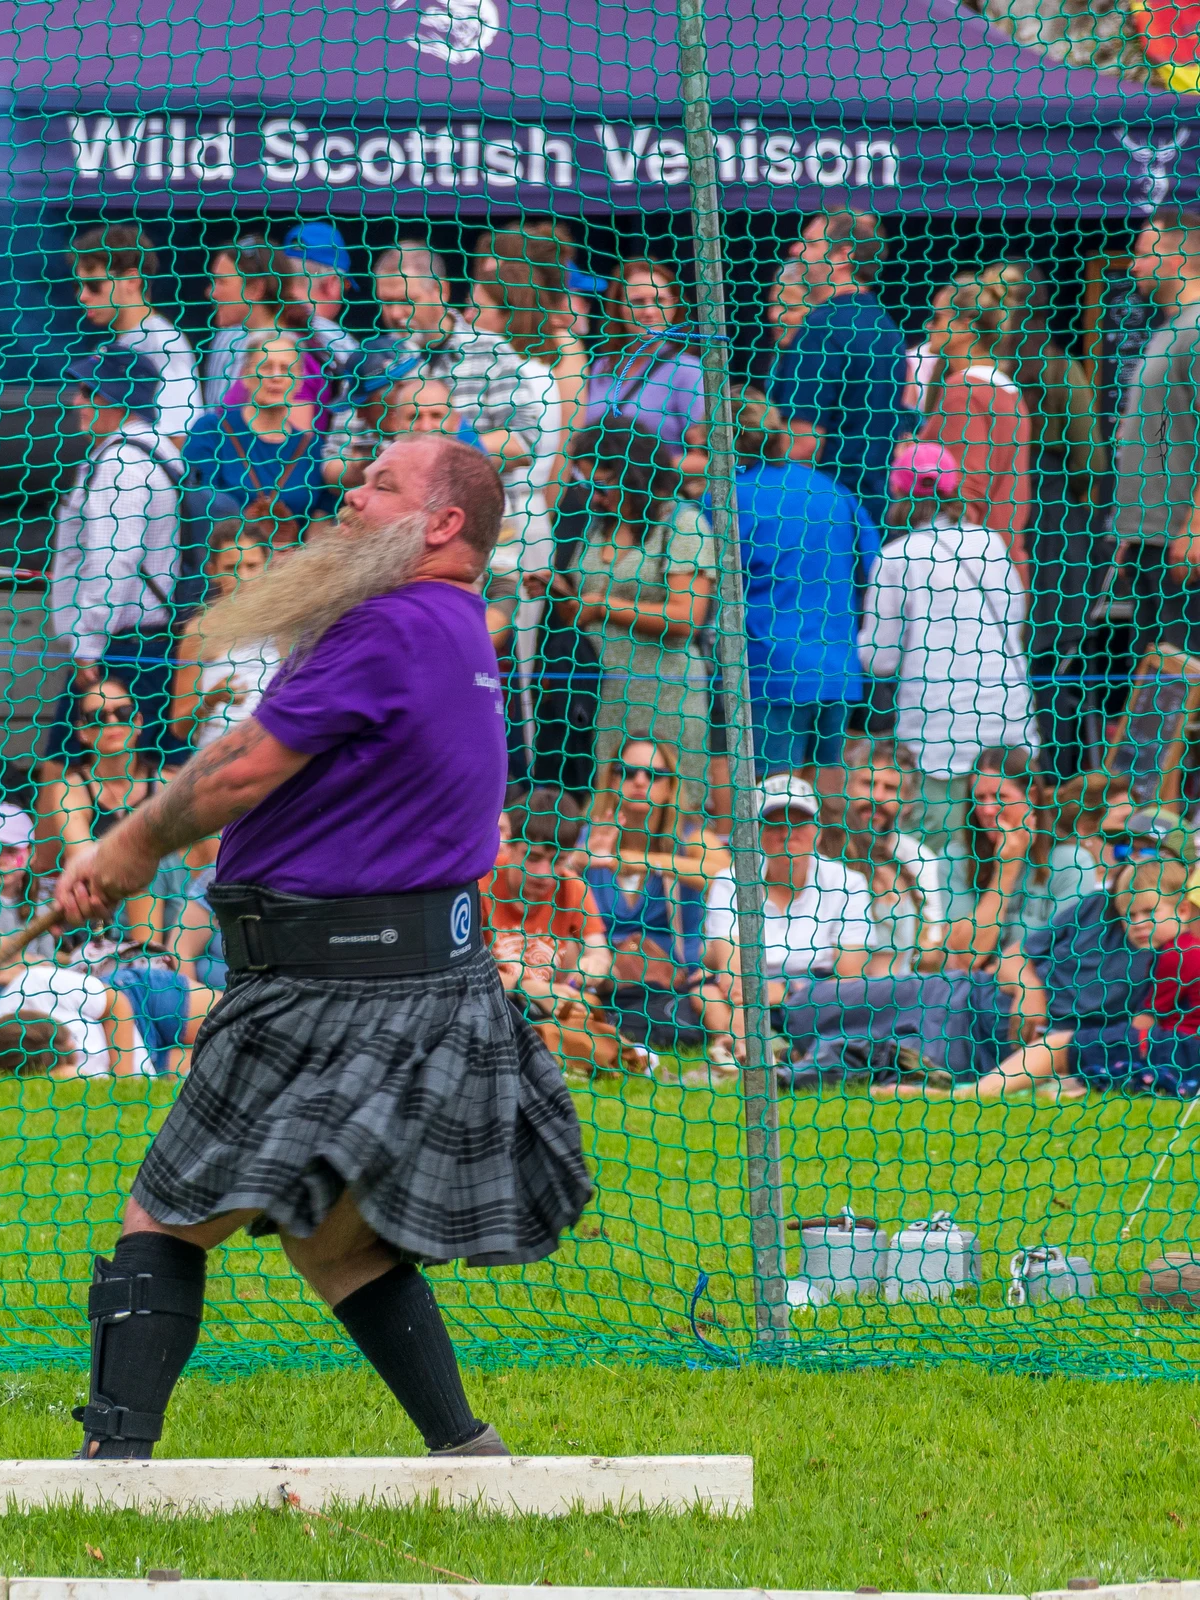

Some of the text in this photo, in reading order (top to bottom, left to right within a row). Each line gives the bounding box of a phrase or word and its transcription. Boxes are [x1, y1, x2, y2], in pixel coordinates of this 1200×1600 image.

[68, 116, 900, 187] Wild Scottish Venison
